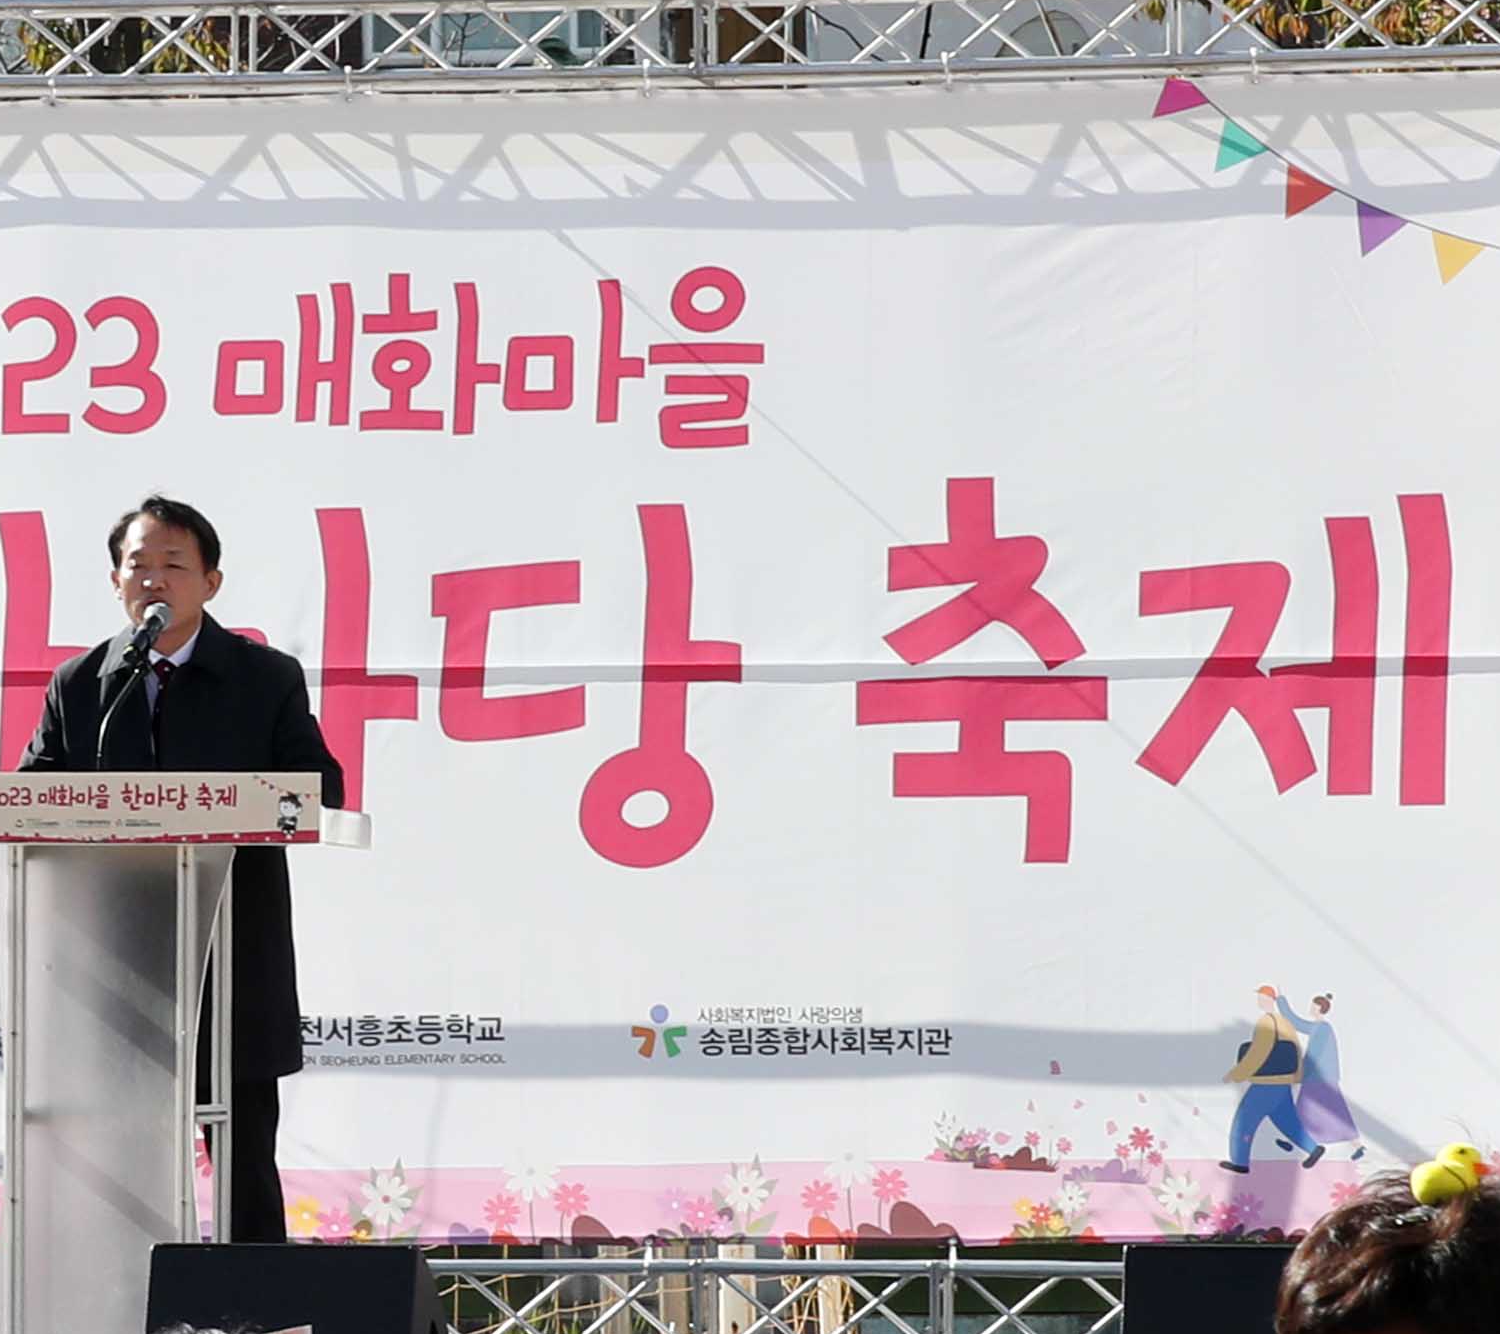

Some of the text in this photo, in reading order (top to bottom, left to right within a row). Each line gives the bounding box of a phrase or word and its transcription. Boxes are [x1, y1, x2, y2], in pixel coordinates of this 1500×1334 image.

[213, 265, 766, 450] 매화마을
[856, 476, 1453, 864] 축제
[38, 783, 111, 810] 매화마을
[120, 782, 189, 811] 한마당
[195, 783, 238, 810] 축제
[697, 1006, 864, 1024] 사회복지법인 사랑의샘
[699, 1026, 953, 1056] 송림종합사회복지관
[319, 1054, 382, 1067] SEOHEUNG
[384, 1053, 456, 1066] ELEMENTARY
[459, 1053, 506, 1065] SCHOOL
